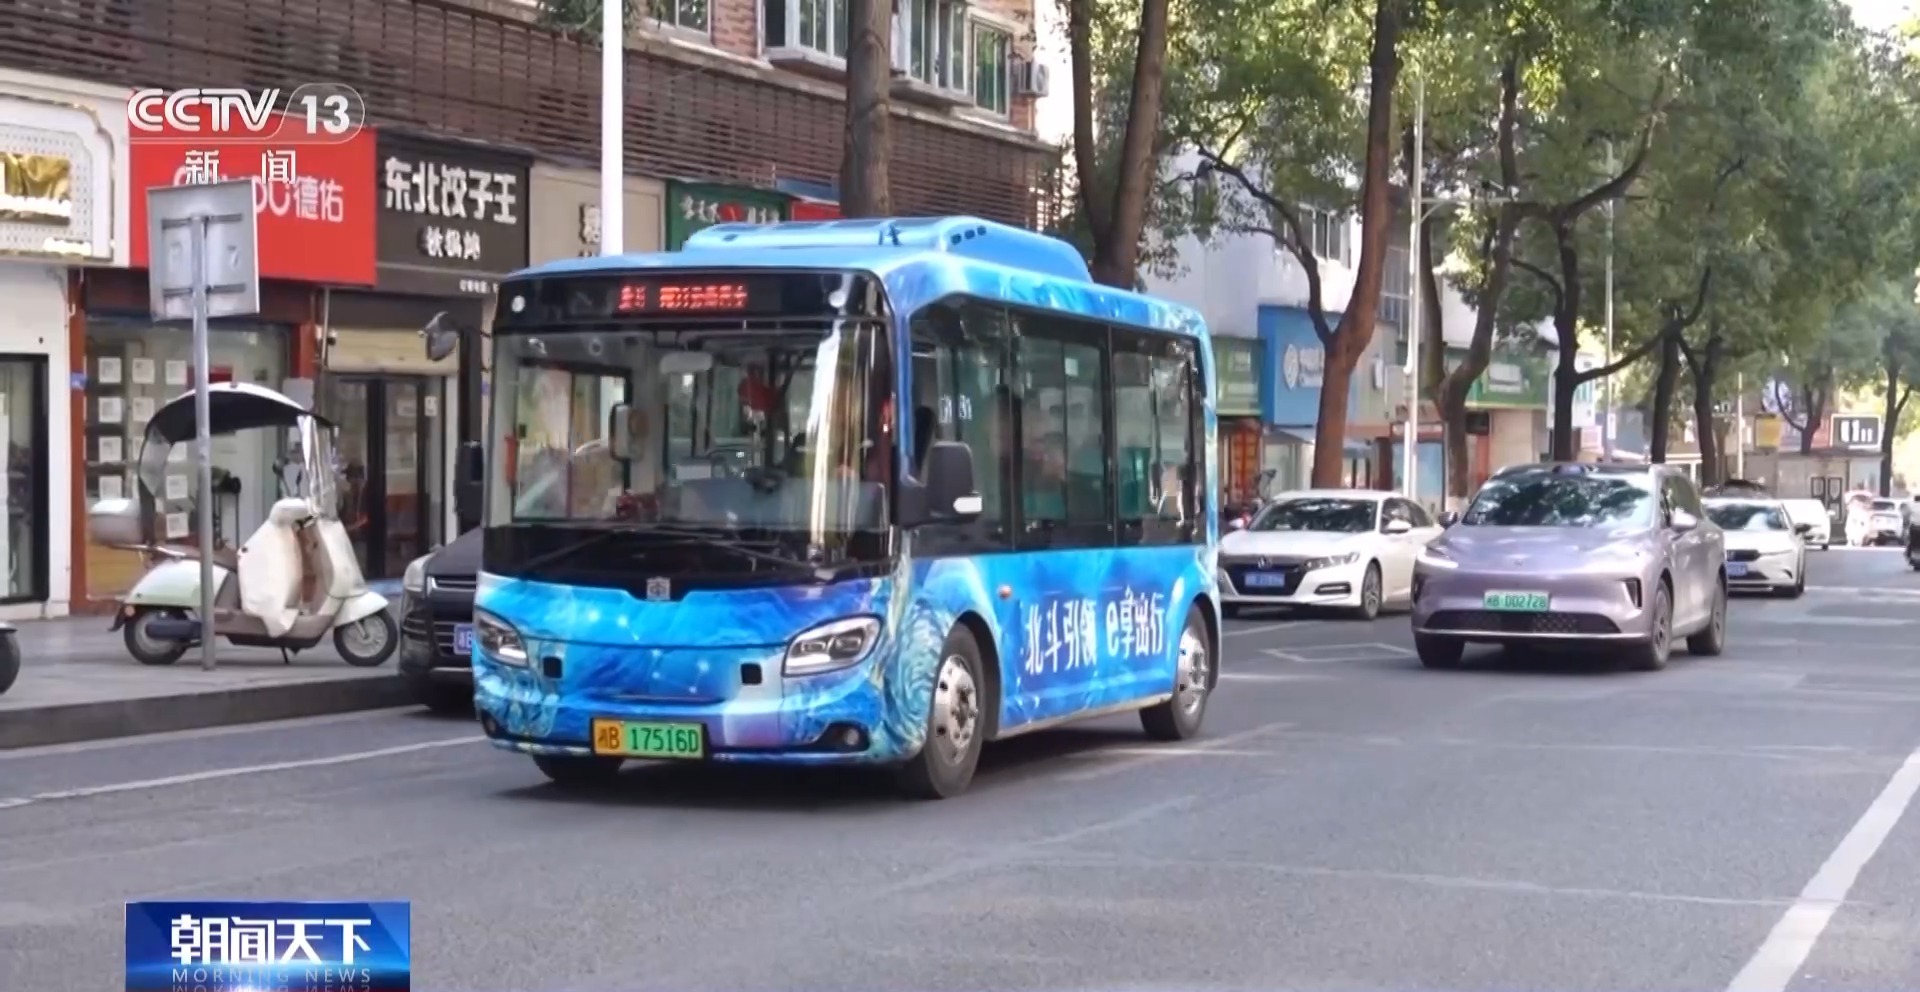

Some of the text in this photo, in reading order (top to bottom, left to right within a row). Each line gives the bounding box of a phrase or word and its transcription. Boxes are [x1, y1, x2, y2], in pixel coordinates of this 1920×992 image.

[294, 175, 344, 223] 德佑
[385, 156, 517, 225] 东北饺子王
[631, 727, 699, 753] 17516D
